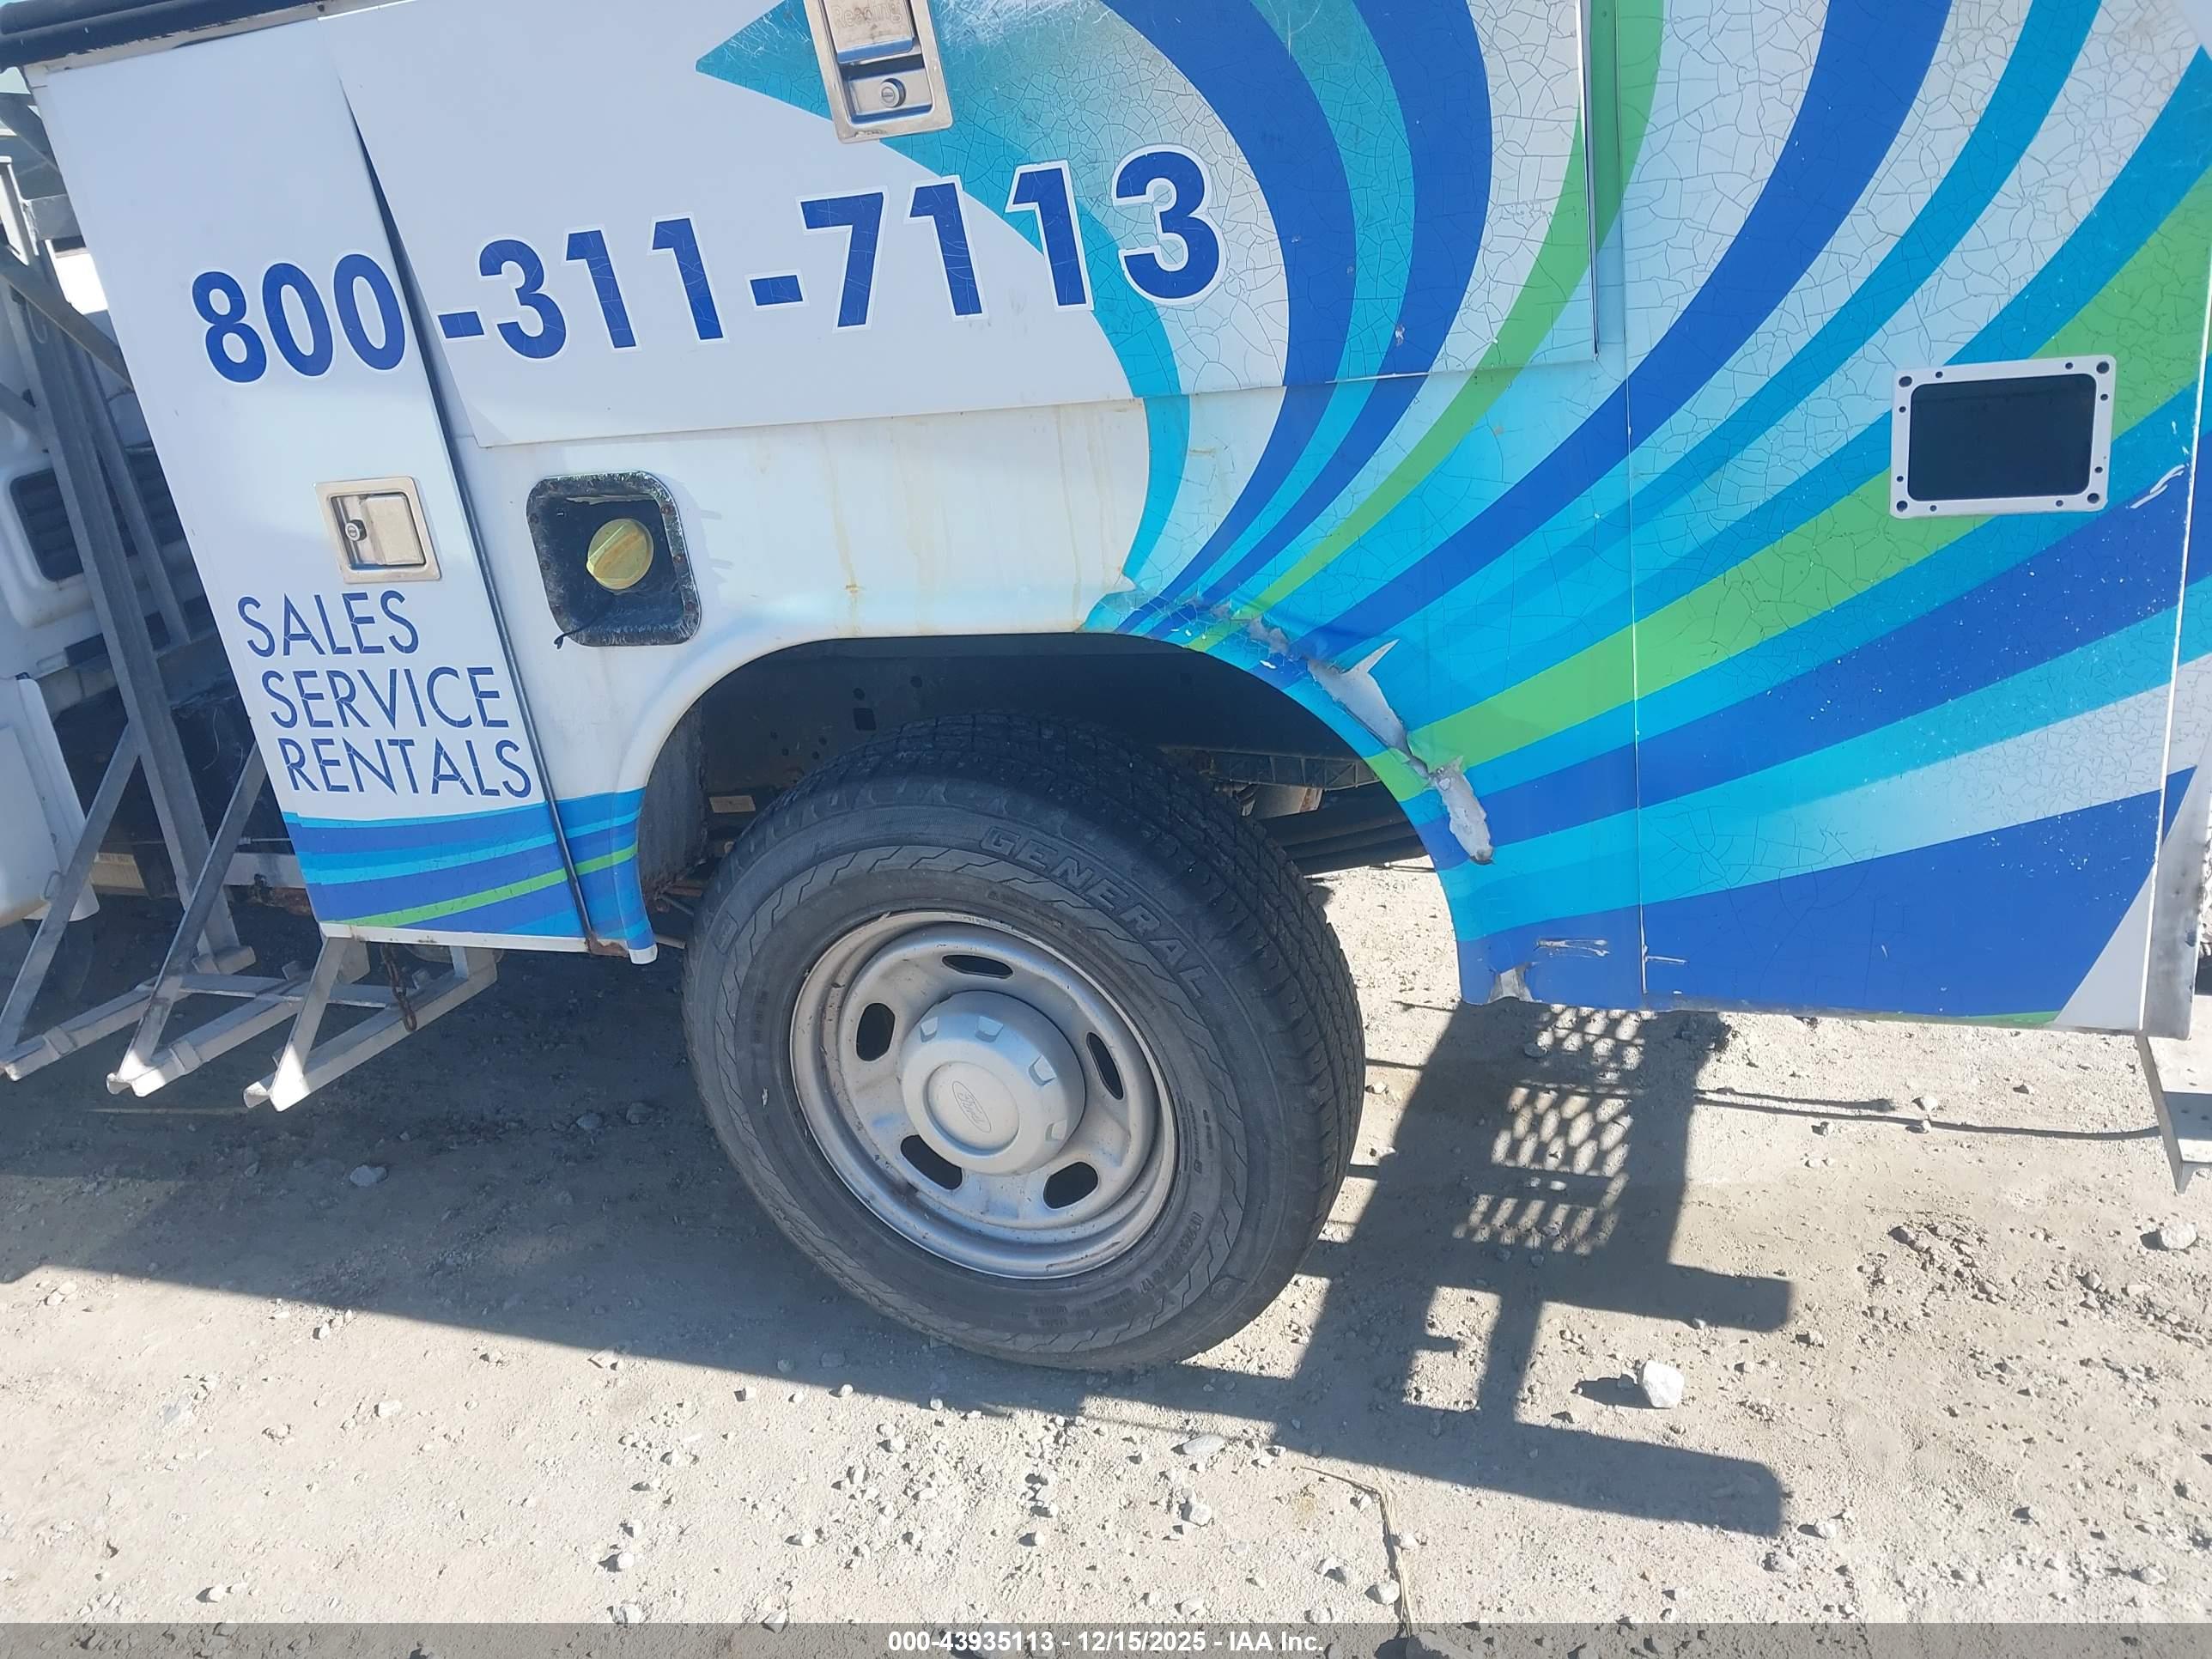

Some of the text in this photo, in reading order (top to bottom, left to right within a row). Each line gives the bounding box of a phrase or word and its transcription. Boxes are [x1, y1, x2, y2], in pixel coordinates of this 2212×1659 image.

[192, 151, 1219, 383] 800-311-7113
[237, 590, 419, 658] SALES
[261, 665, 510, 731] SERVICE
[277, 736, 532, 799] RENTALS
[979, 825, 1211, 999] GENERAL
